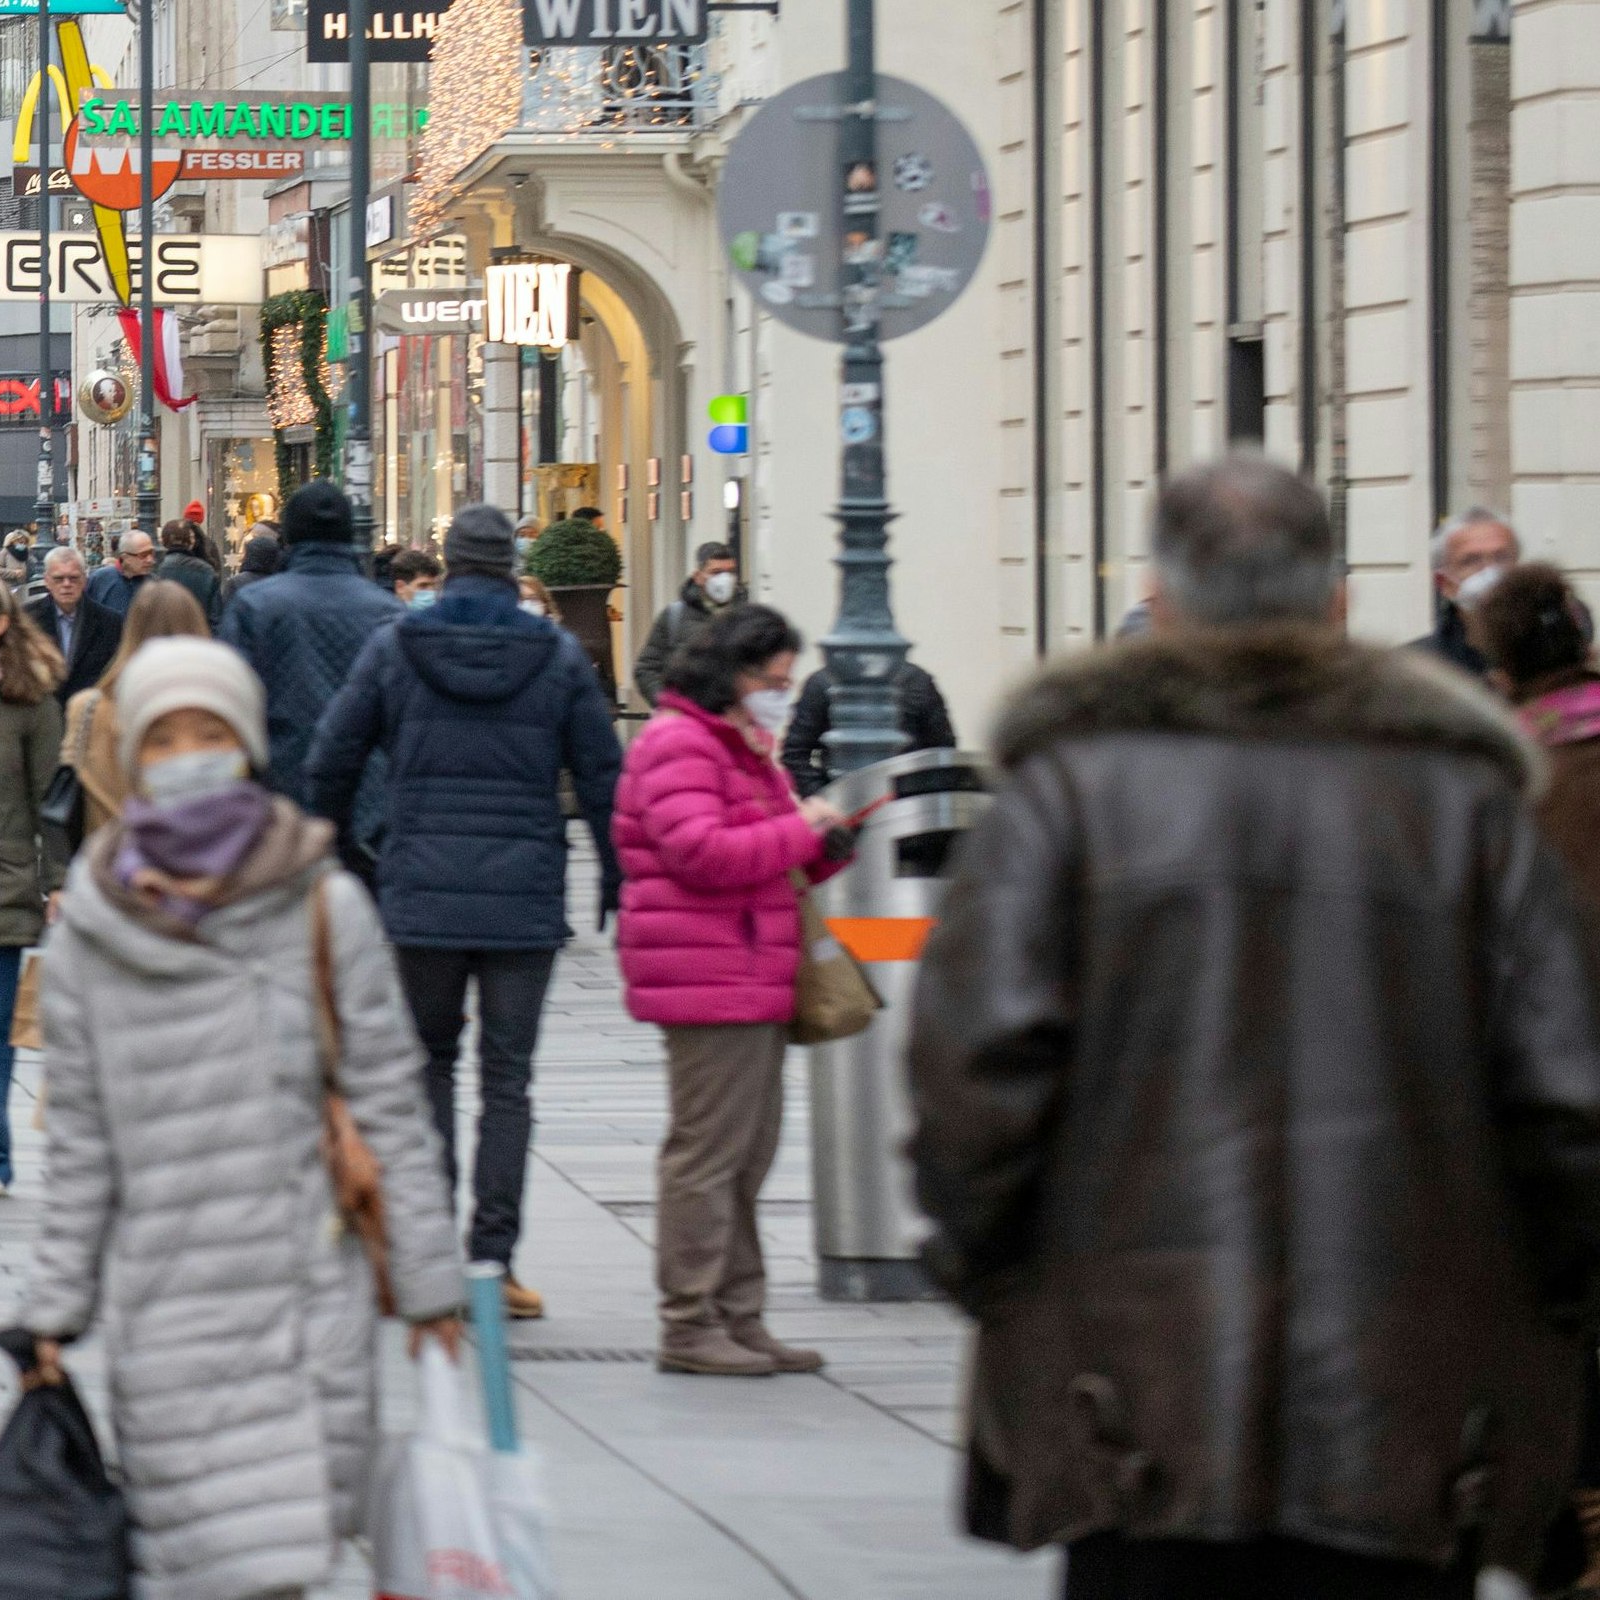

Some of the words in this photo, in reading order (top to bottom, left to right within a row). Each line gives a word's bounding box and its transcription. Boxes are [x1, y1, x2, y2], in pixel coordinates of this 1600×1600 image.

[323, 12, 441, 39] HLLH
[533, 0, 700, 38] WIEN
[82, 97, 353, 140] SAAMANDE
[186, 151, 302, 171] FESSLER
[6, 240, 201, 296] BRE
